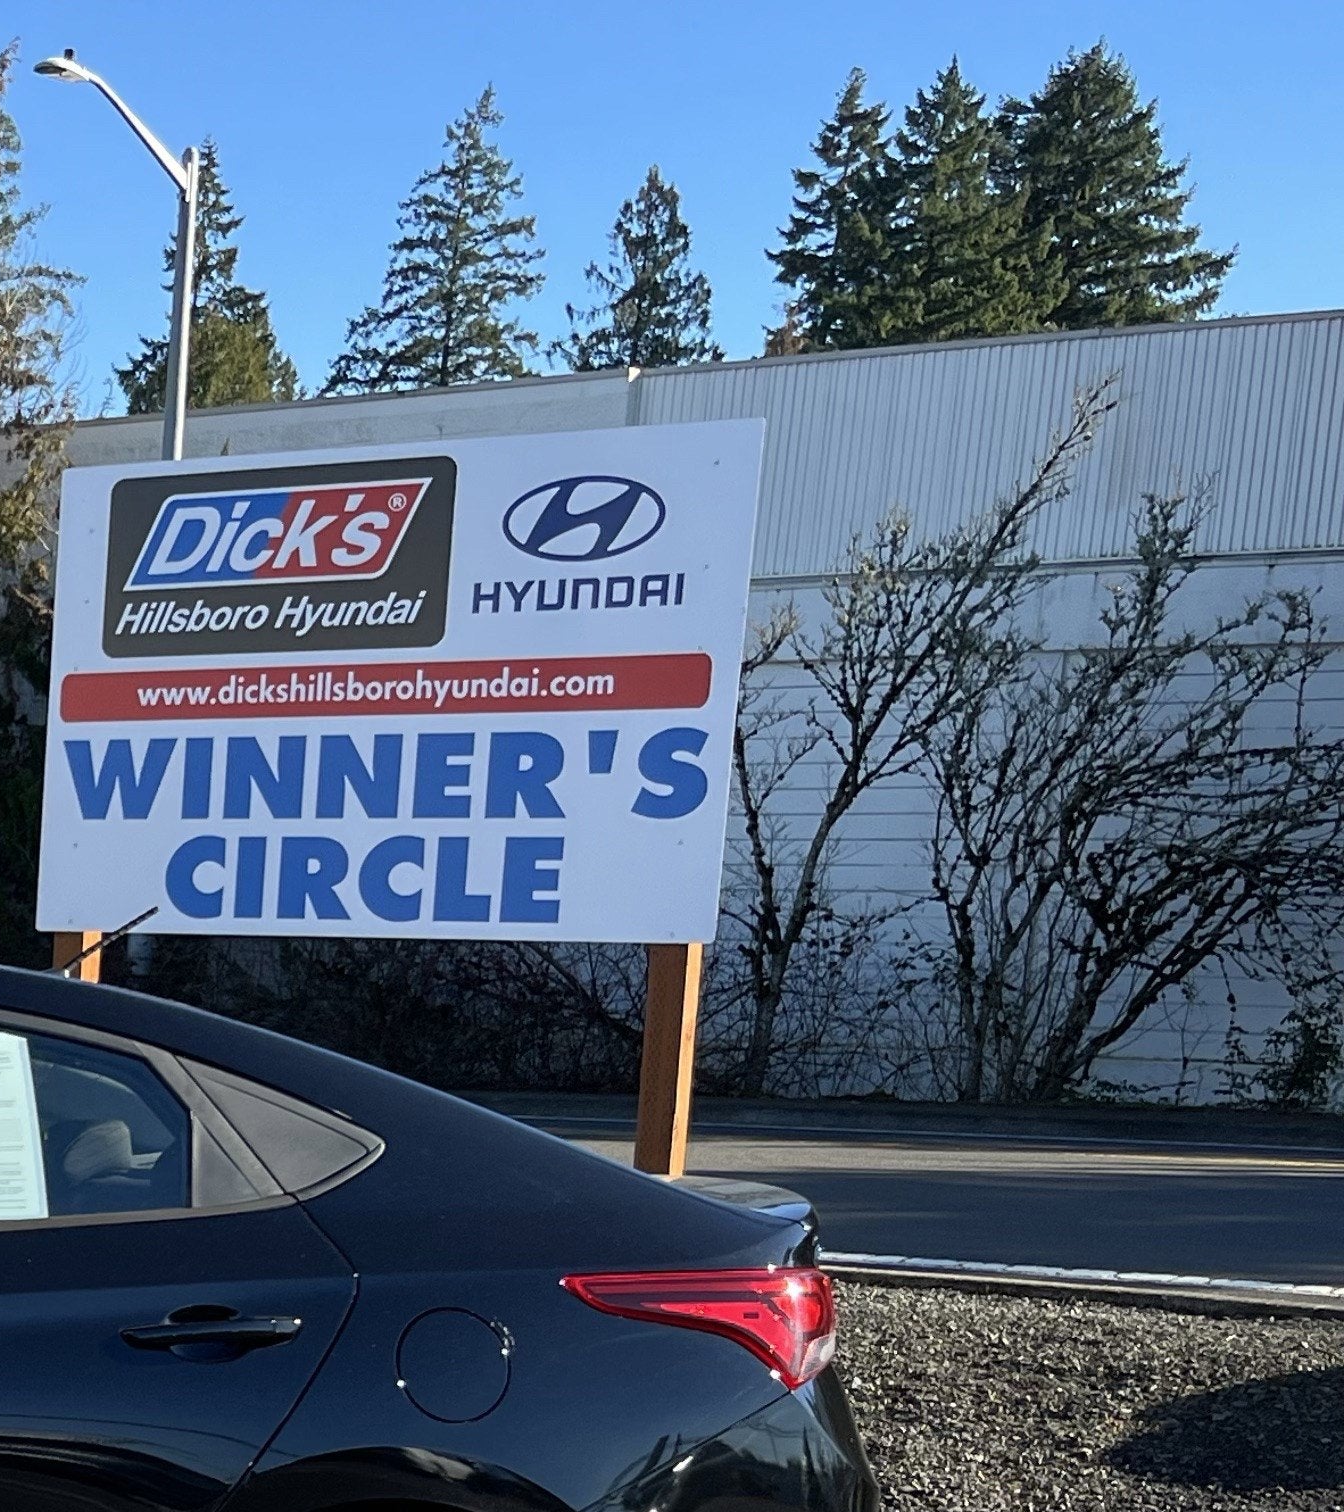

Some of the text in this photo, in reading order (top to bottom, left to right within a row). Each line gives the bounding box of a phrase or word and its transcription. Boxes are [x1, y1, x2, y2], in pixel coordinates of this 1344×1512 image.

[147, 493, 390, 576] Dick's
[115, 590, 428, 636] Hillsboro Hyundai
[471, 572, 685, 614] HYUNDAI
[137, 669, 614, 707] www.dickshillsborohyundai.com
[63, 727, 709, 820] WINNER'S
[165, 834, 565, 923] CIRCLE
